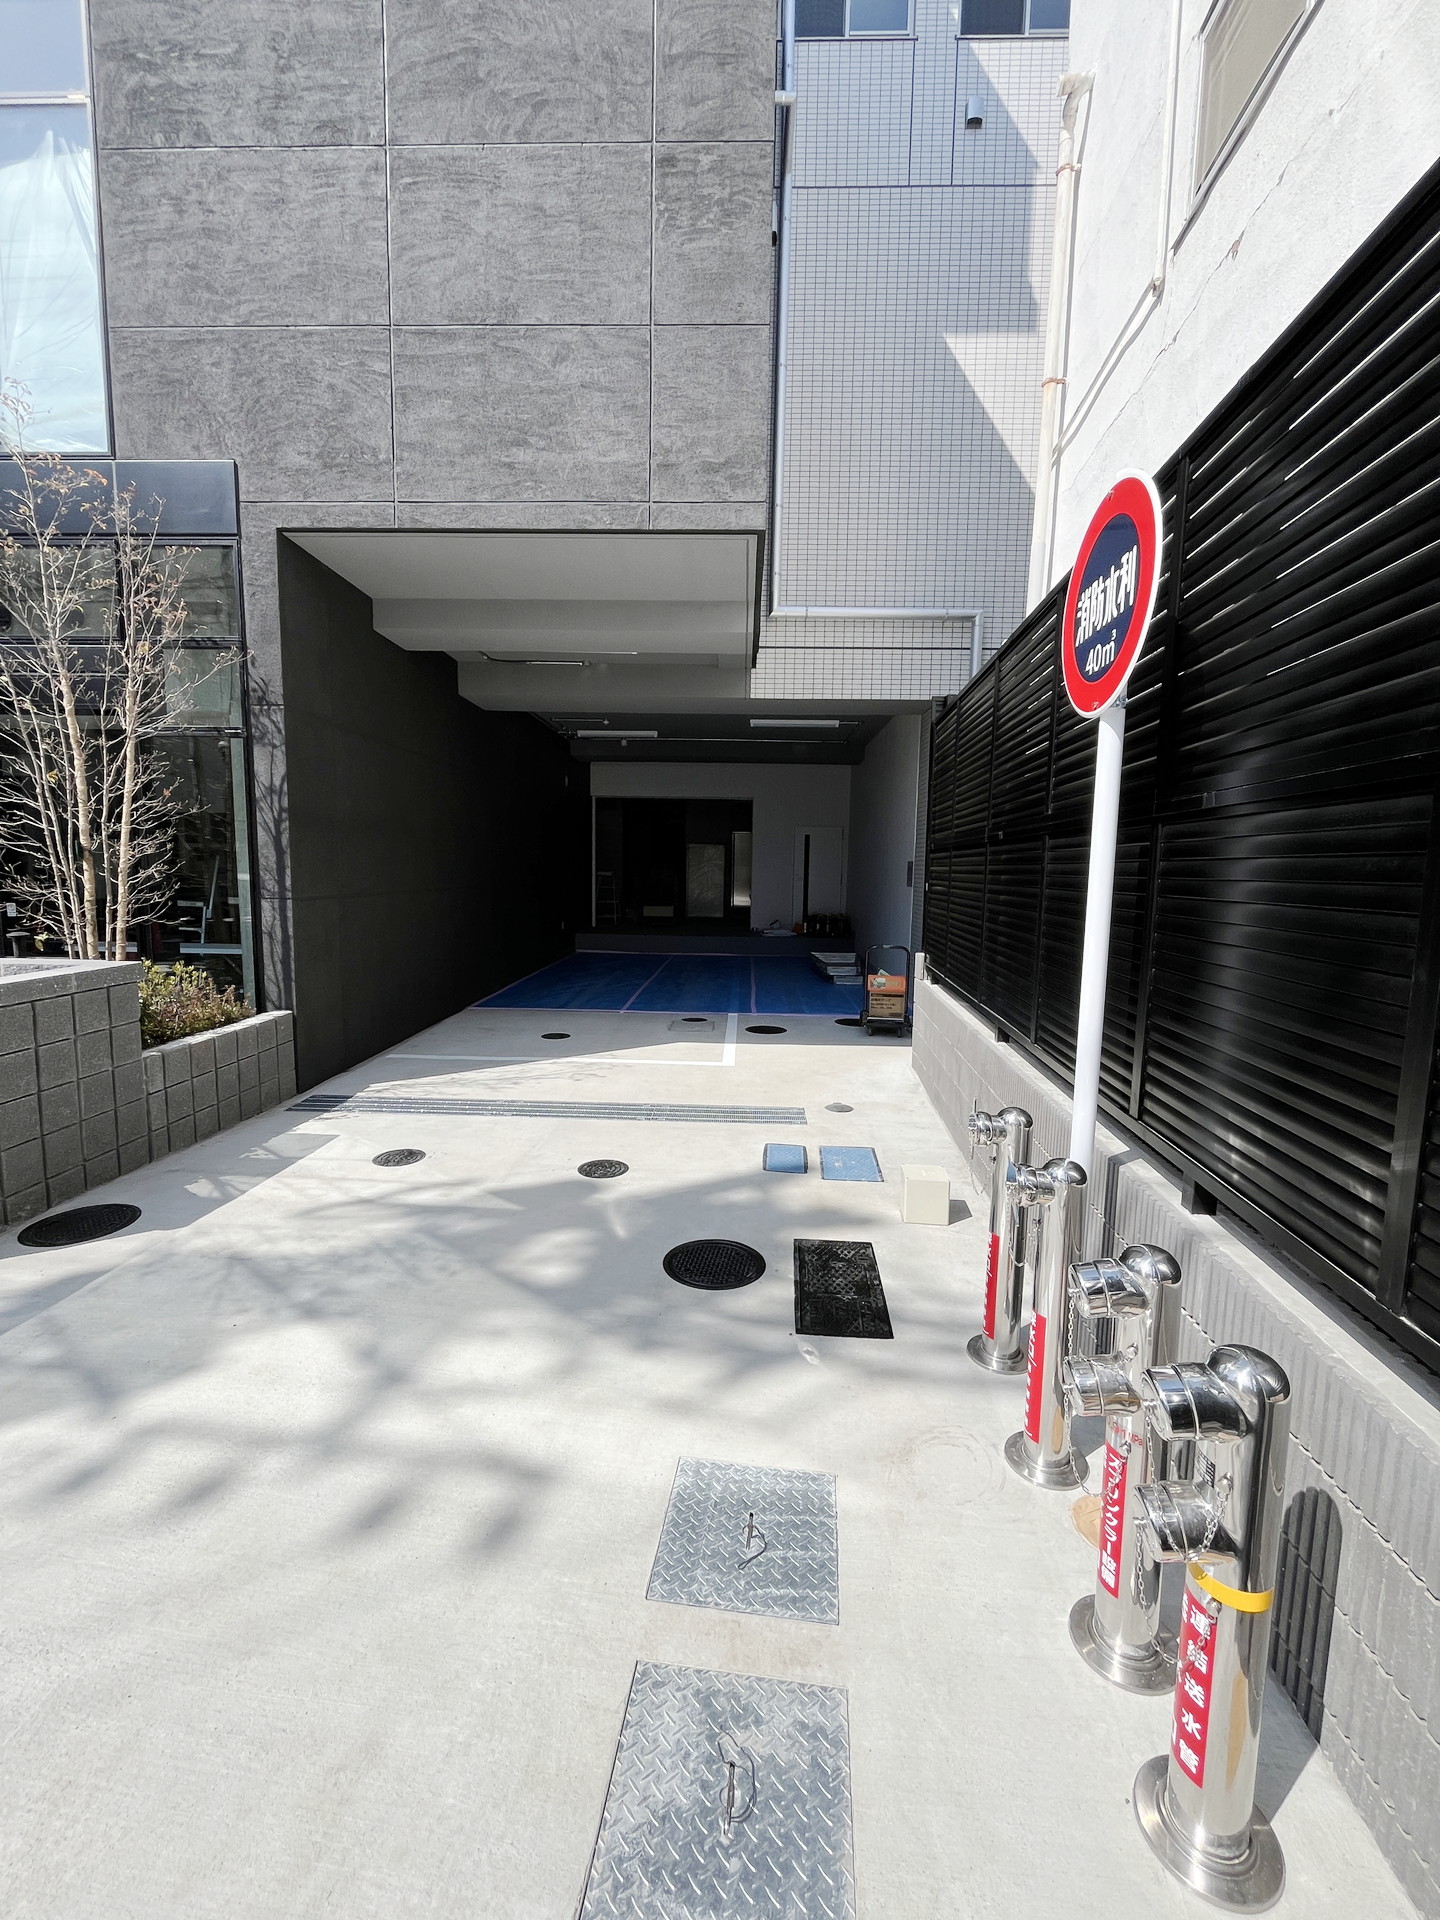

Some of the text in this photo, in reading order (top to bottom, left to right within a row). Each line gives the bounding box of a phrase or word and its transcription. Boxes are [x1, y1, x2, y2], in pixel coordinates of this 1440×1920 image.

[1076, 544, 1137, 648] 消防水利
[1179, 1604, 1211, 1775] 連結送水管
